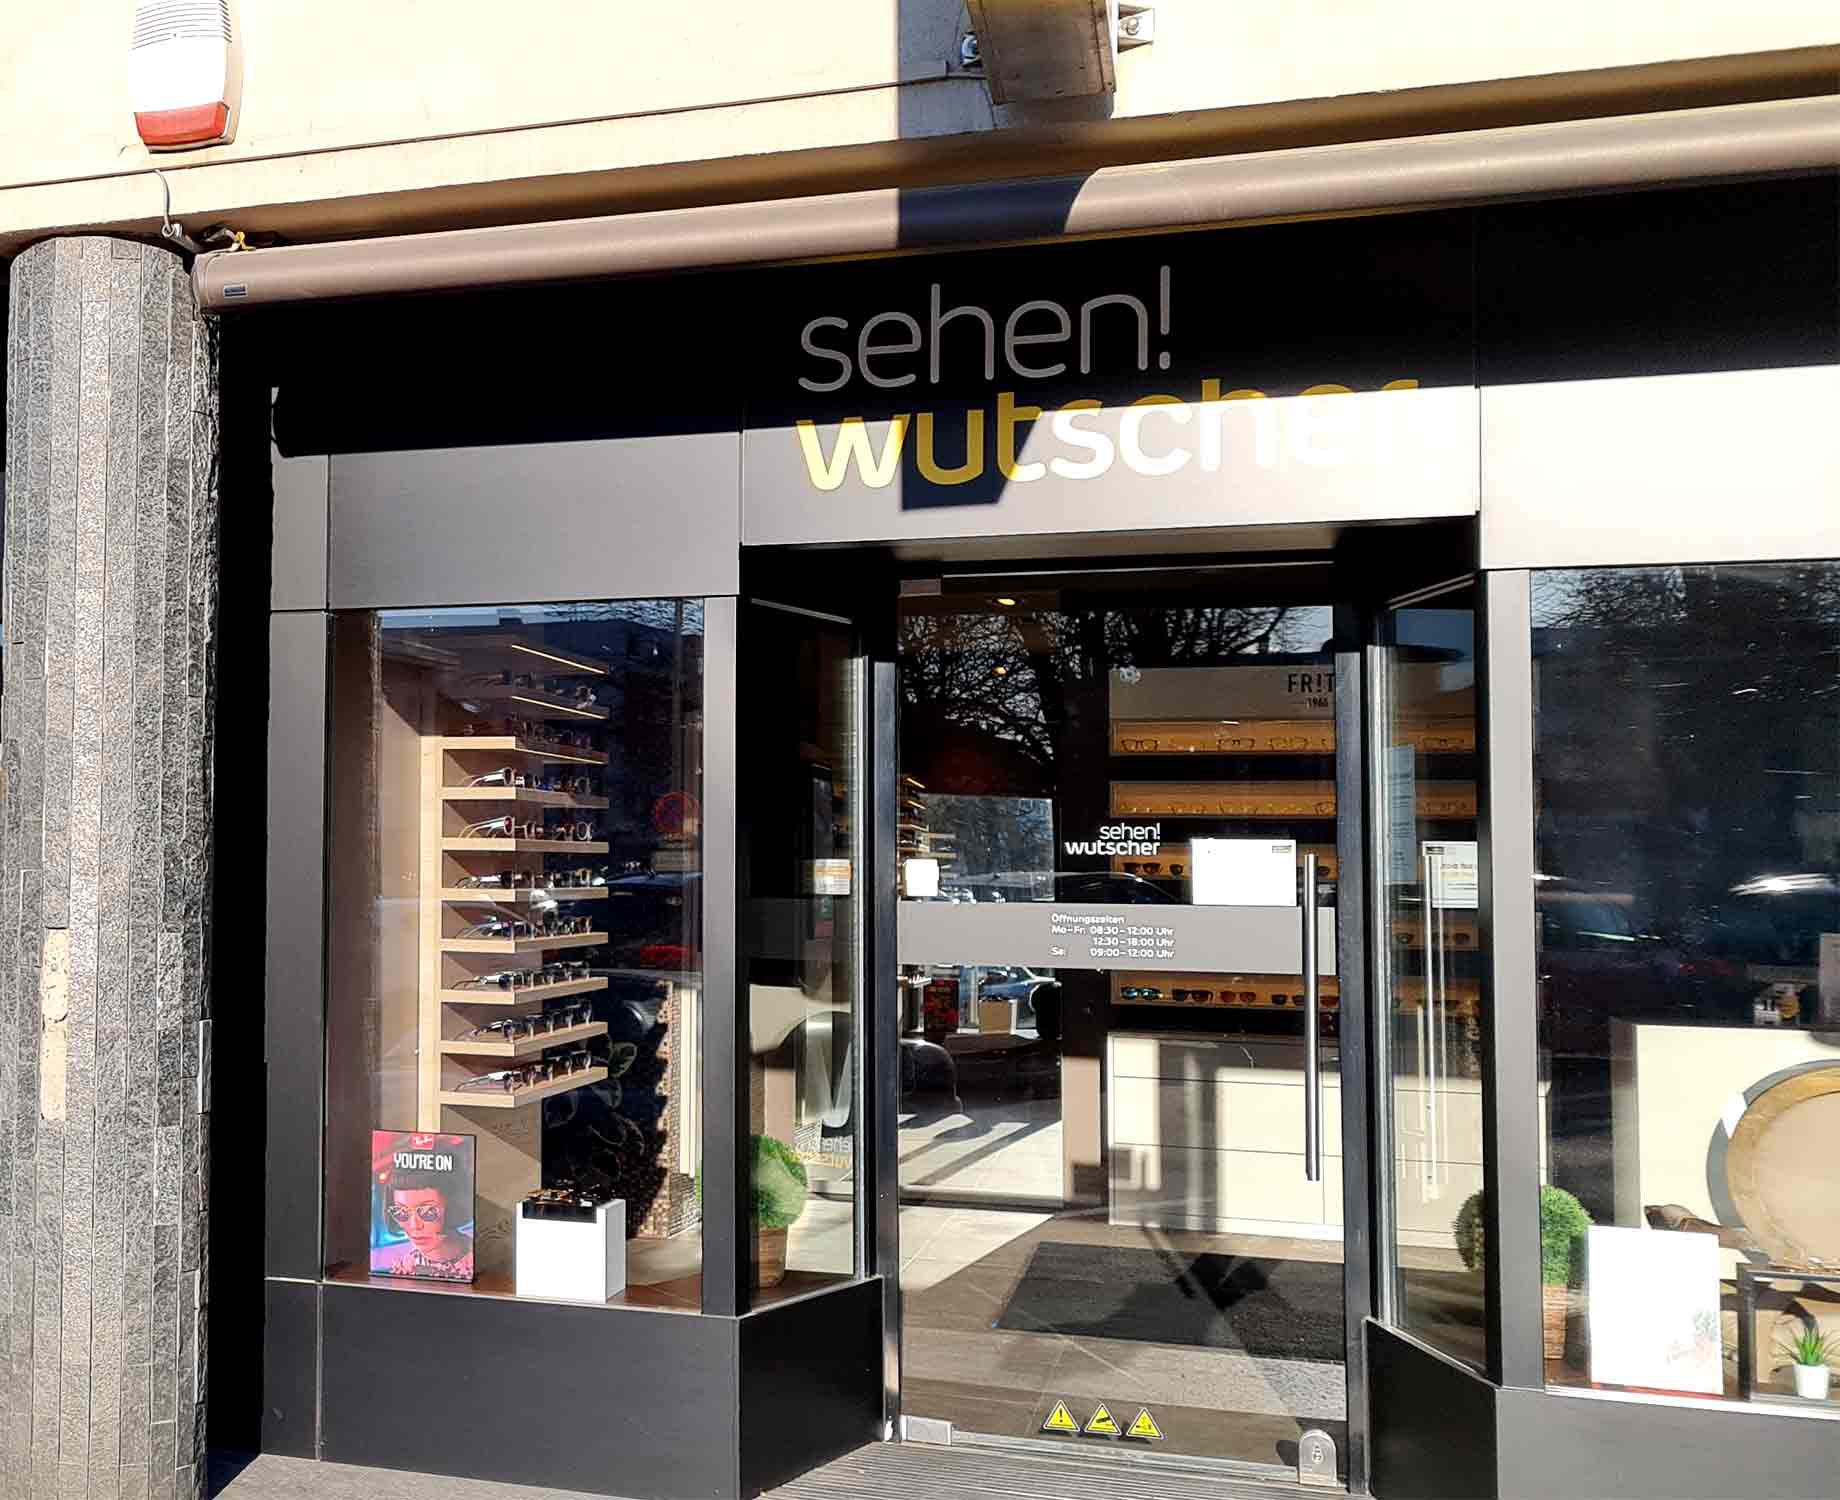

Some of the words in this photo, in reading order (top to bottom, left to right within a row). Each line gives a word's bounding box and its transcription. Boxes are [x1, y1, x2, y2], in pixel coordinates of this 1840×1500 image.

[799, 265, 1171, 391] sehen!
[795, 378, 1420, 492] wutsche
[1287, 672, 1336, 693] FR!T
[1099, 822, 1161, 840] sehen!
[1064, 840, 1161, 856] wutscher
[393, 1152, 434, 1170] YOU'RE
[435, 1154, 453, 1171] ON
